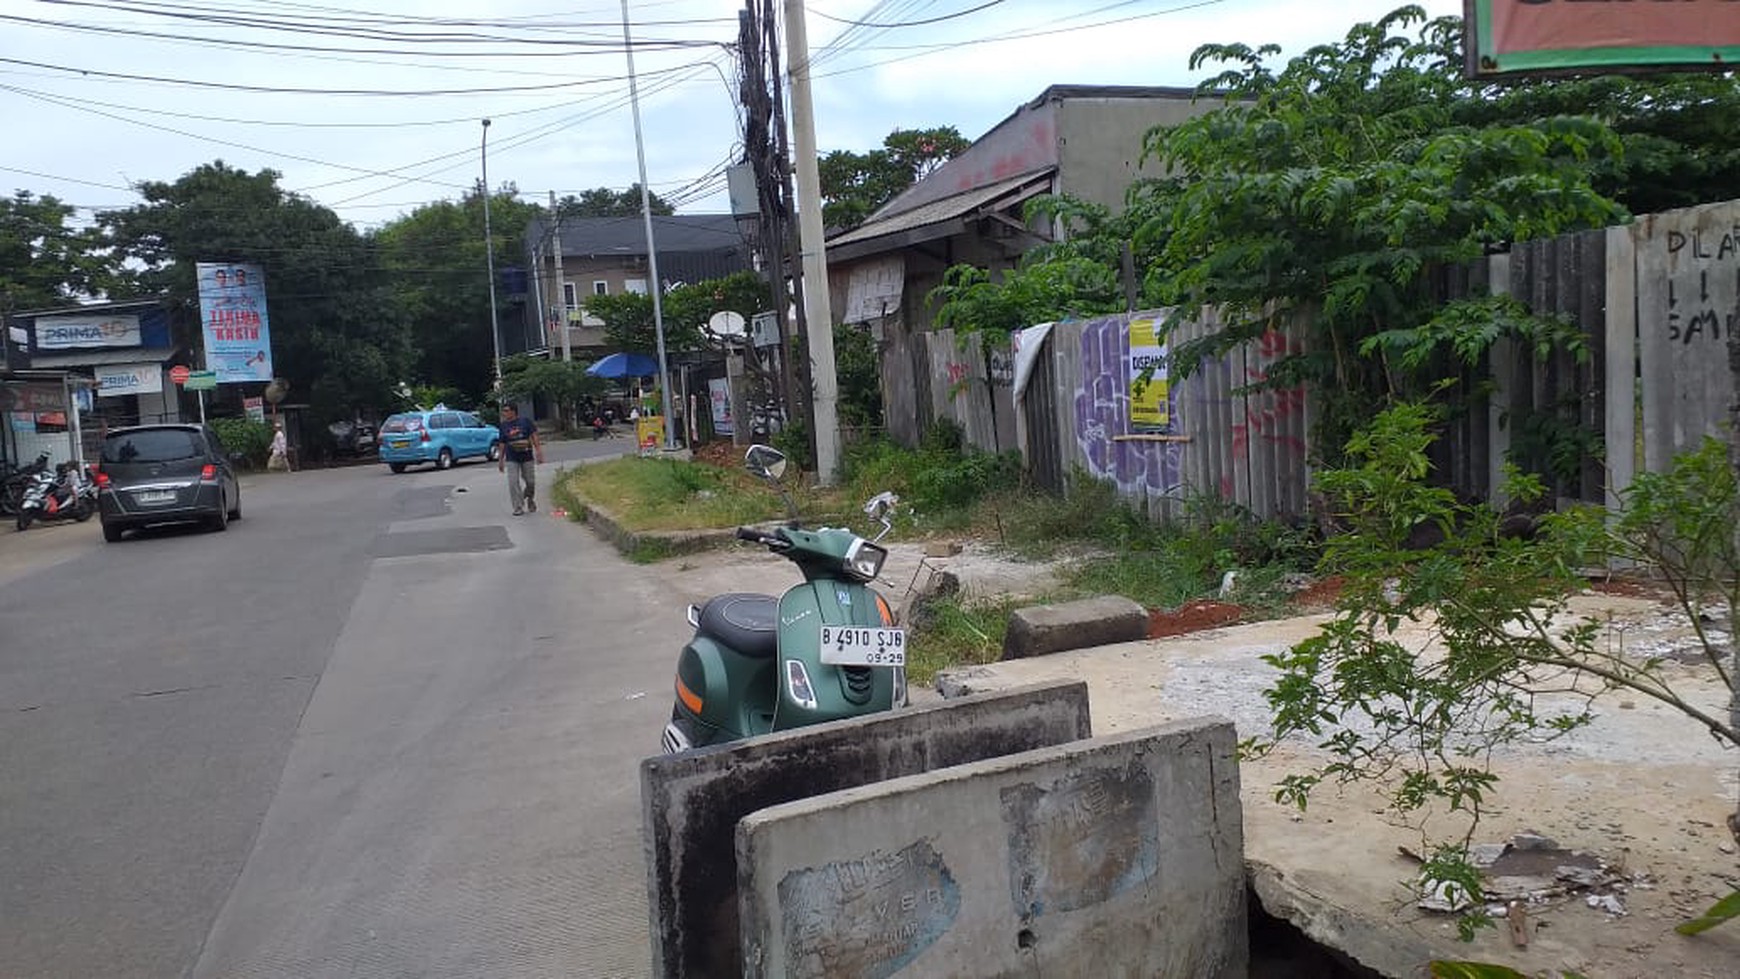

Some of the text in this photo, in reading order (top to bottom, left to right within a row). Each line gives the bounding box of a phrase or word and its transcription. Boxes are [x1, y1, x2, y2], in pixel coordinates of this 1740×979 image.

[44, 326, 102, 340] PRIMA
[101, 374, 139, 388] PRIMA
[822, 628, 831, 644] B
[837, 629, 869, 646] 4910
[866, 653, 903, 663] 09-29
